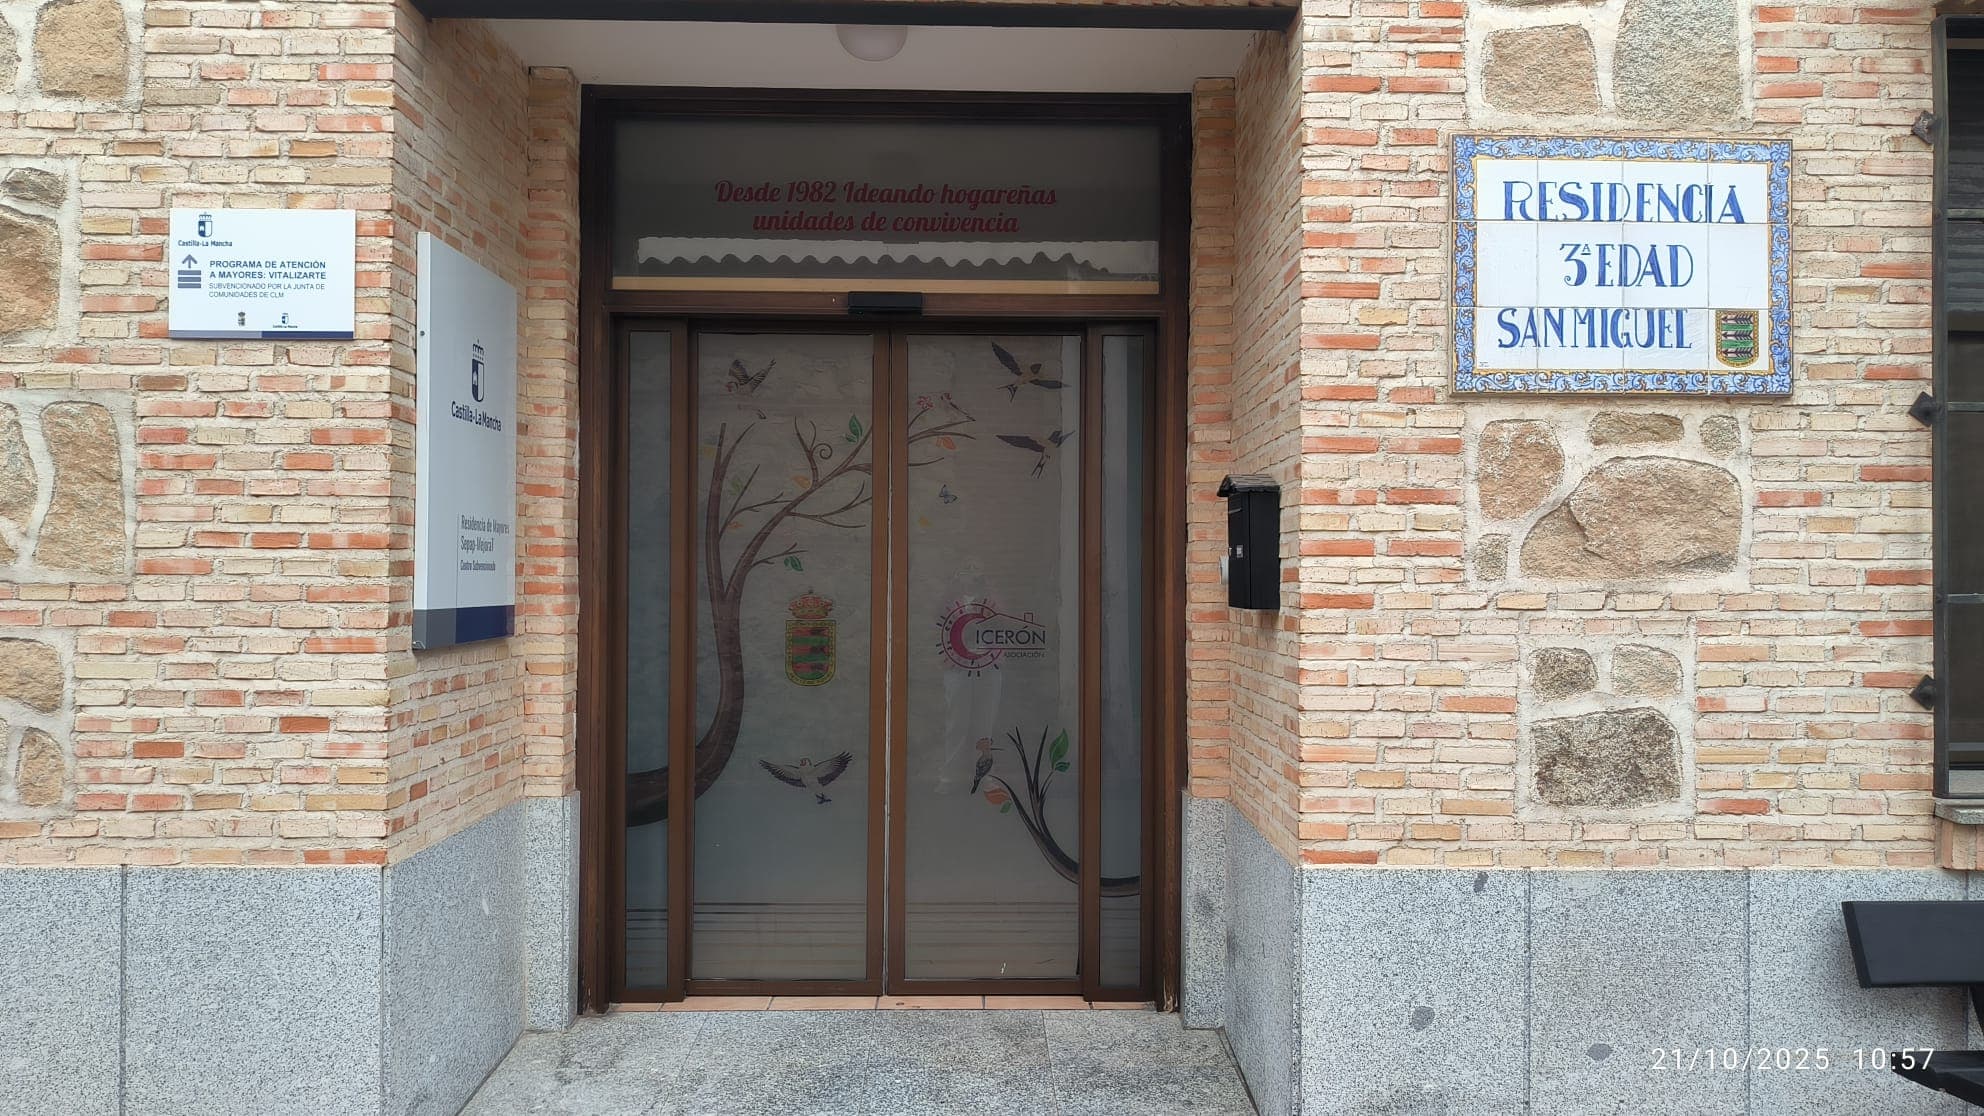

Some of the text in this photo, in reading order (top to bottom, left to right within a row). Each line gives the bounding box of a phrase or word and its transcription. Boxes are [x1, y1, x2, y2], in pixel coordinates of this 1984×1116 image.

[715, 180, 1057, 210] Desde 1982 Ideando hogareñas
[1502, 181, 1745, 224] RESIDENCIA
[752, 210, 1020, 232] unidades de convivencia
[211, 239, 233, 247] Mancha
[209, 260, 326, 269] PROGRAMA DE ATENCIÓN
[1595, 244, 1694, 287] EDAD
[209, 271, 327, 280] A MAYORES: VITALIZARTE
[209, 282, 266, 290] SUBVENCIONADO
[482, 410, 501, 431] Mancha
[461, 514, 485, 532] Residencia
[486, 517, 492, 532] de
